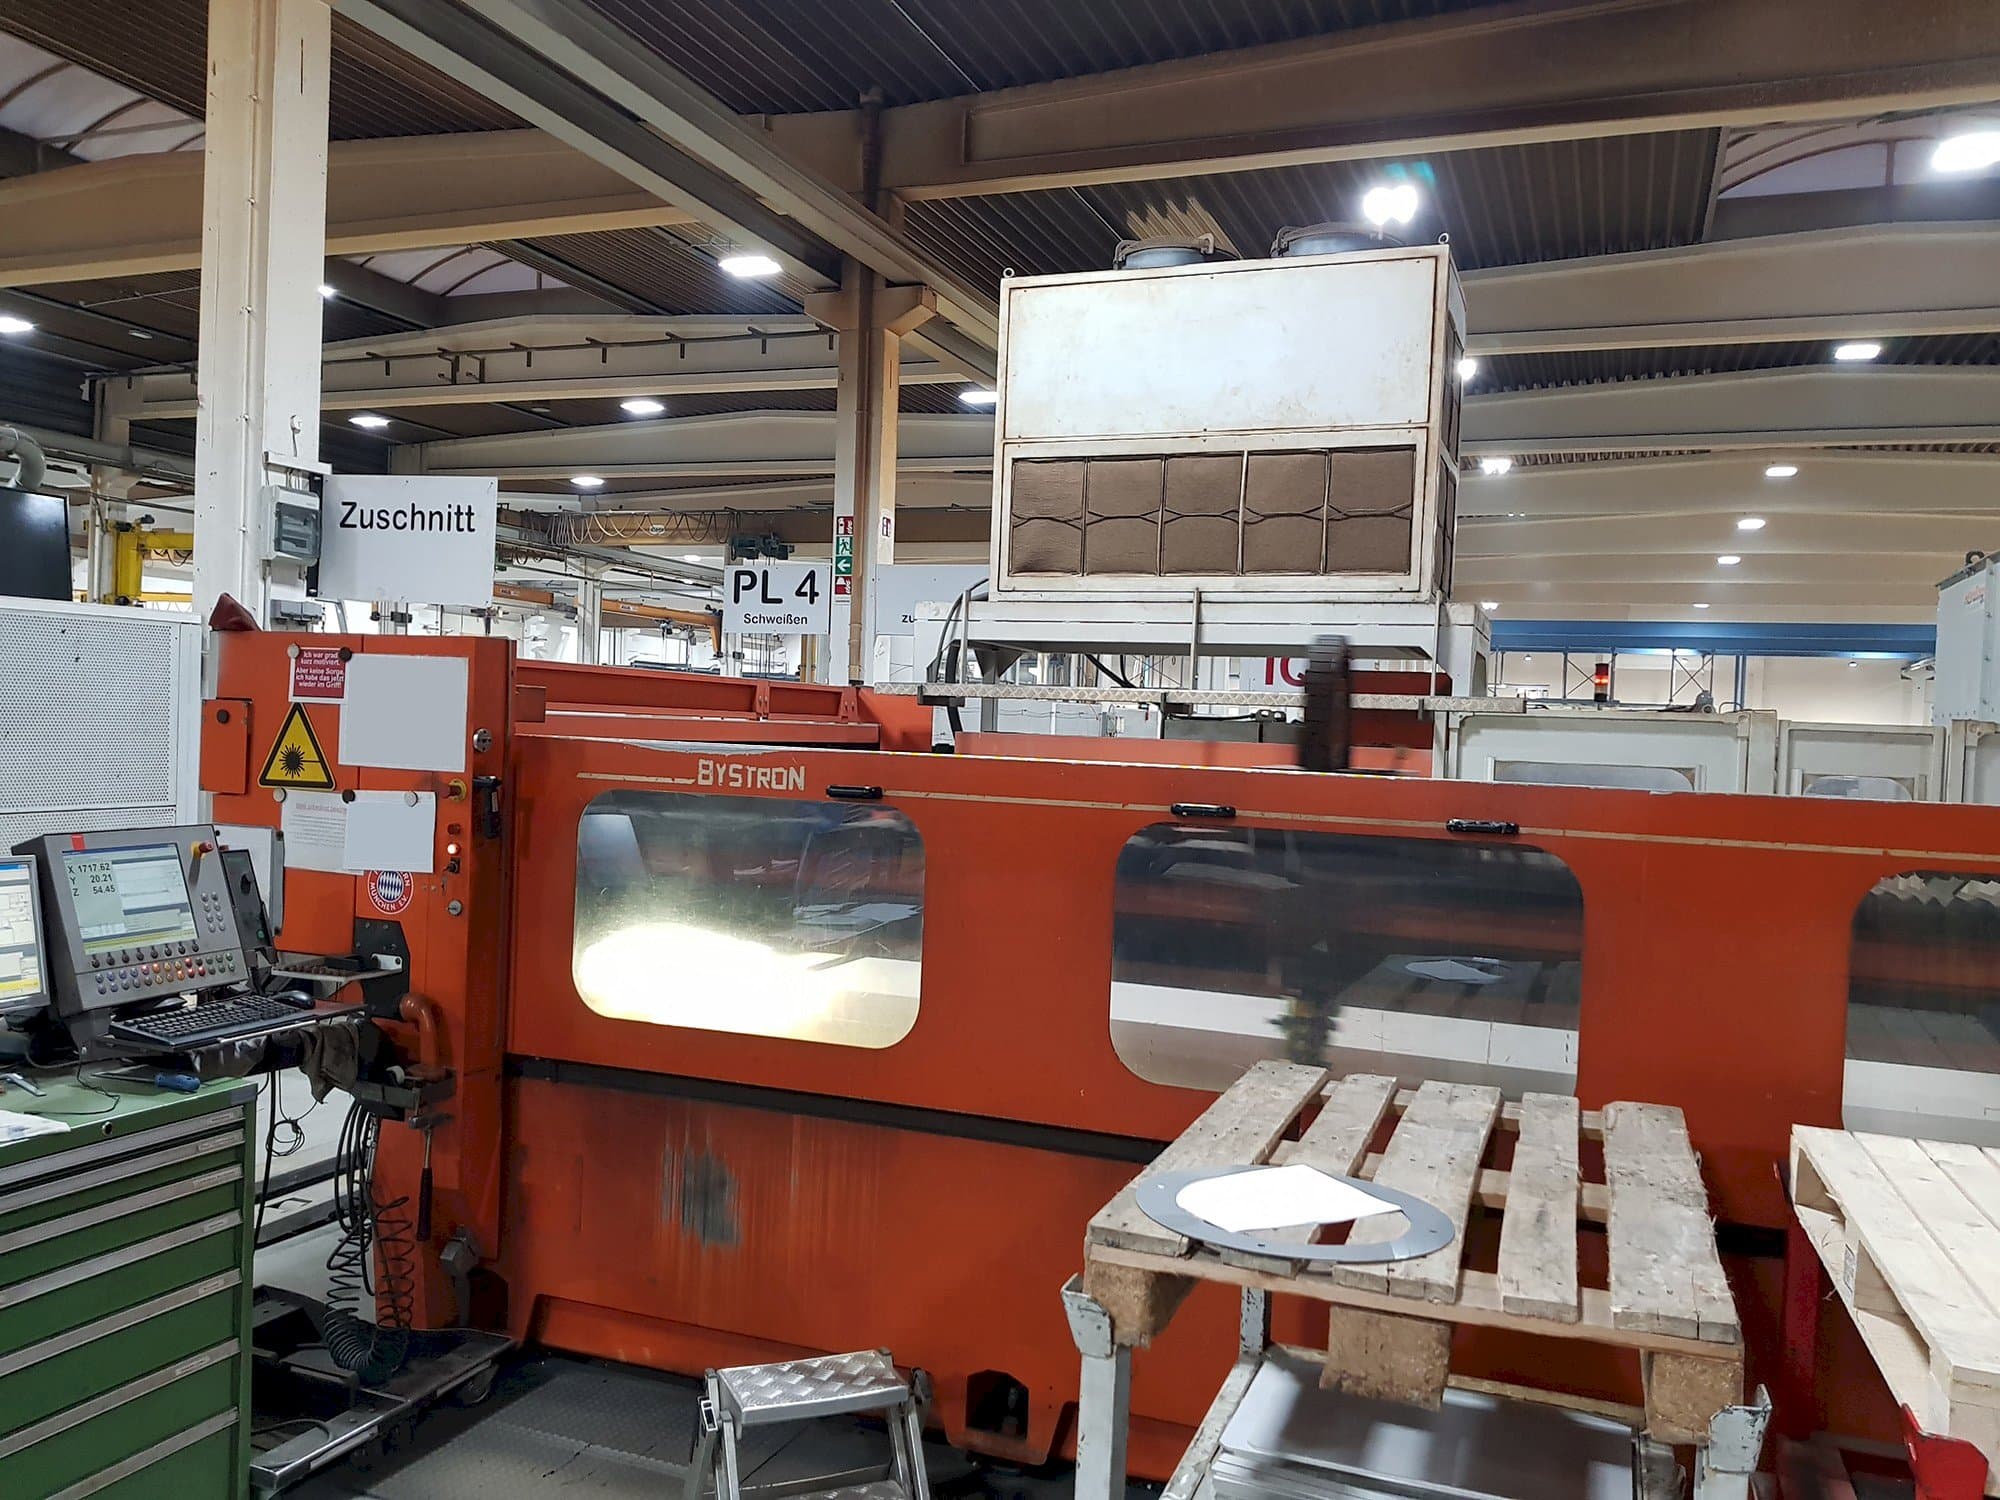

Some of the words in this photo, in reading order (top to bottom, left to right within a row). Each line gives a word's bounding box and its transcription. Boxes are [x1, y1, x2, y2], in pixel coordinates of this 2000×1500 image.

[339, 501, 475, 532] Zuschnitt
[733, 569, 783, 605] PL
[795, 569, 820, 605] 4
[743, 613, 808, 625] Schweißen
[697, 759, 805, 791] BYSTRON
[67, 865, 75, 873] X
[70, 876, 76, 885] Y
[72, 888, 79, 896] Z
